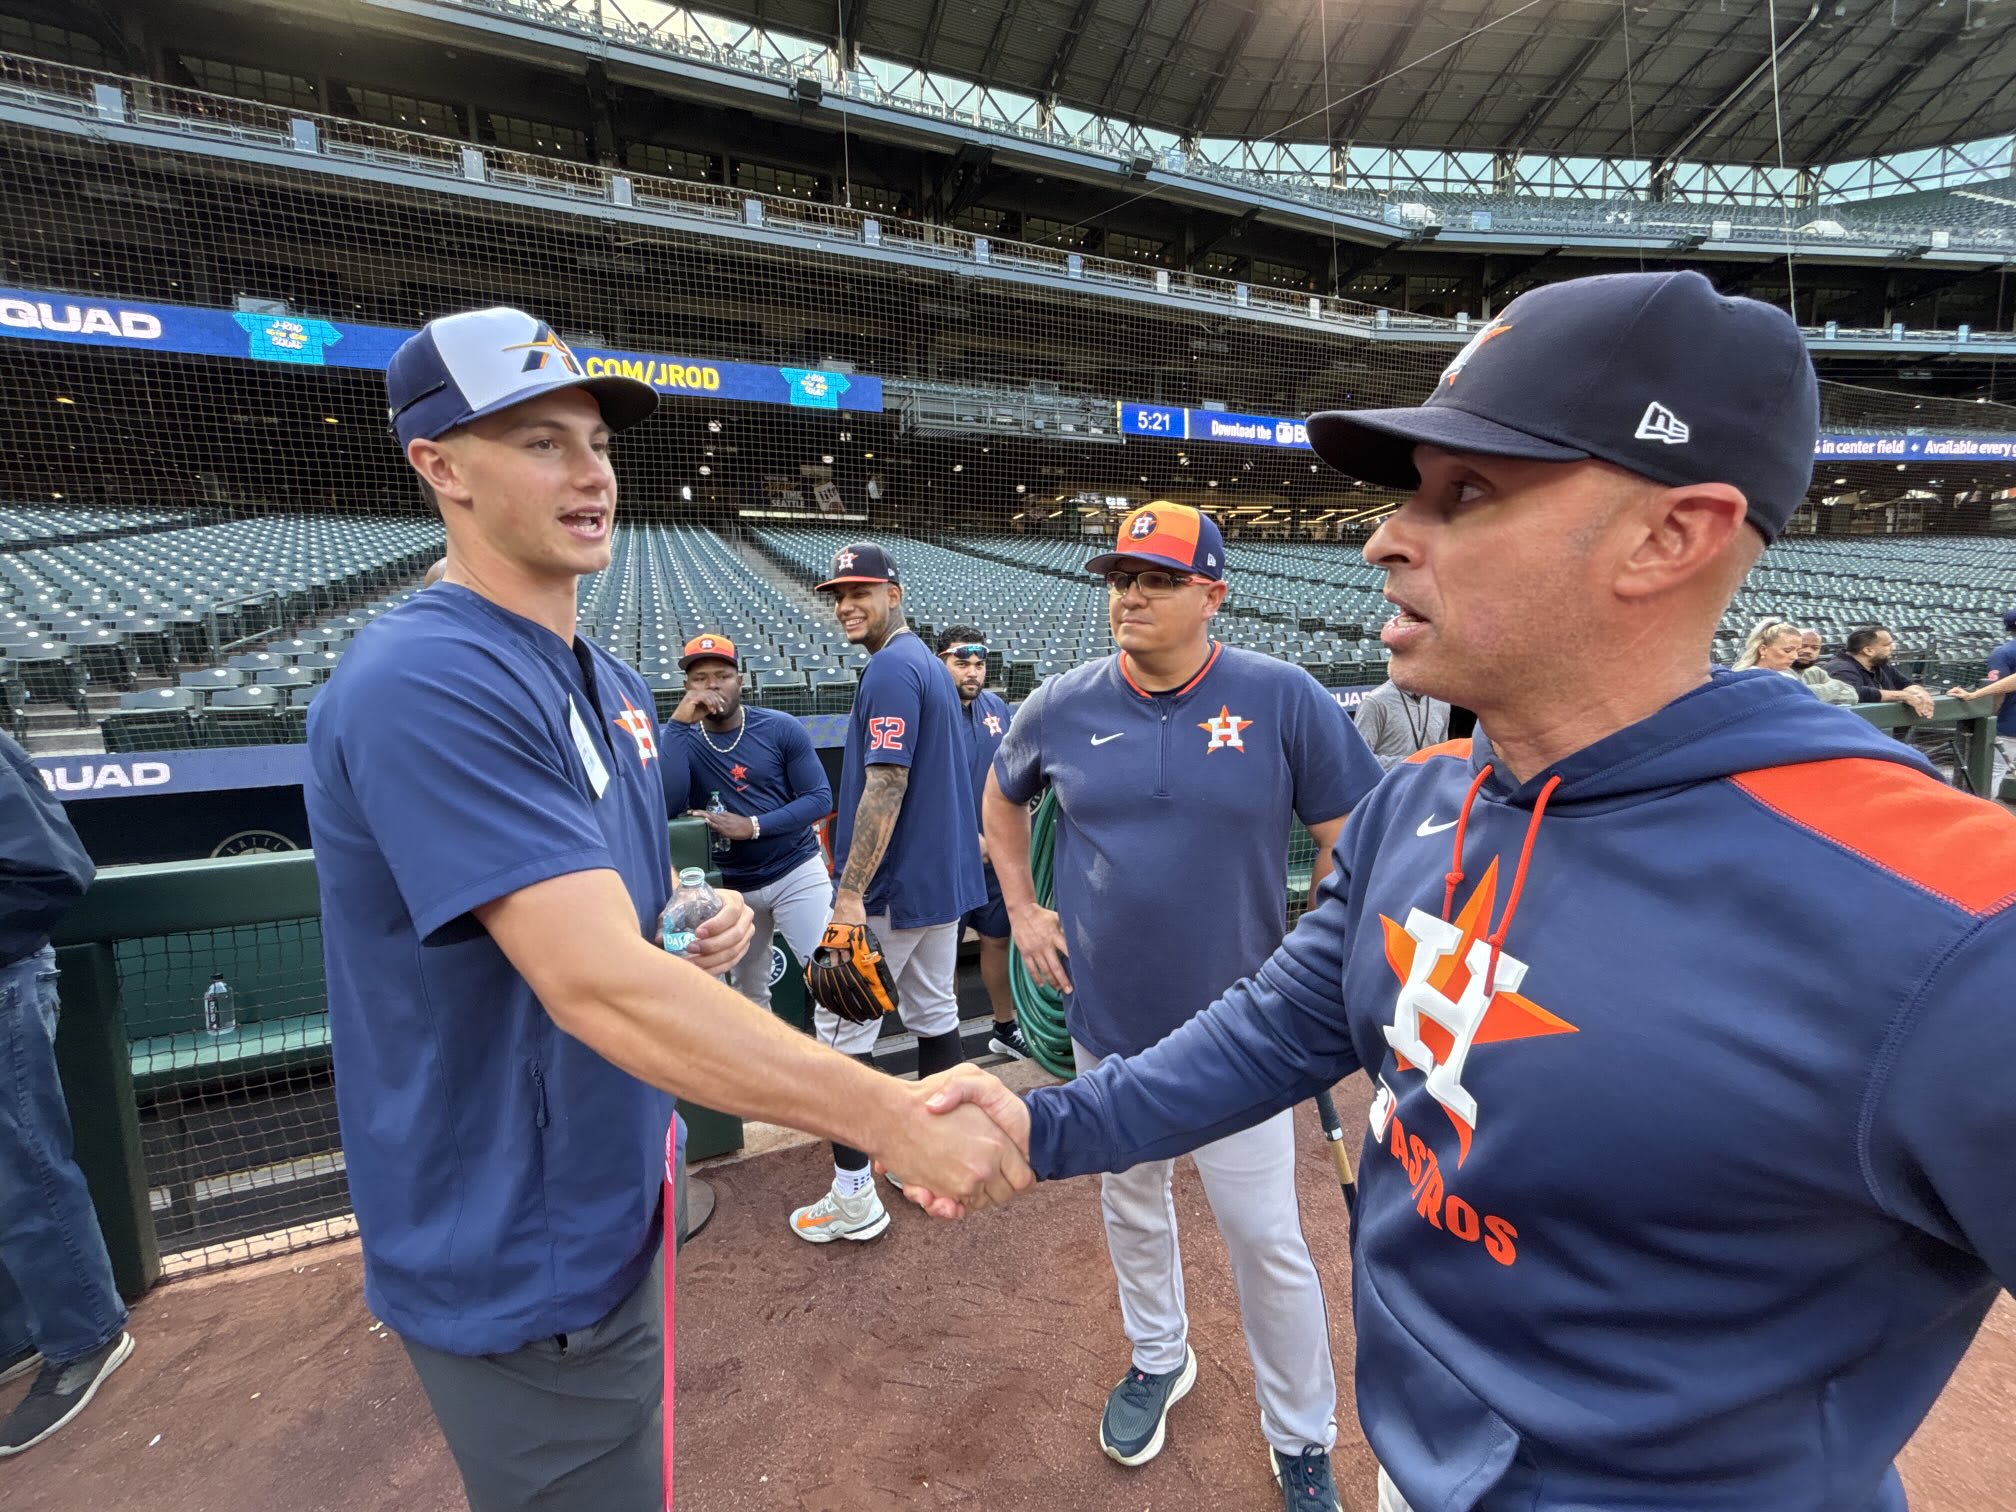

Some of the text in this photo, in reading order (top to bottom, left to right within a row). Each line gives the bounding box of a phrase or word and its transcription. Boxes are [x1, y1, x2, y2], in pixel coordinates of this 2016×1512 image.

[0, 298, 162, 339] QUAD
[1137, 412, 1170, 430] 5:21
[1212, 420, 1255, 439] Download
[1257, 424, 1272, 440] the
[1822, 440, 1835, 454] in
[1836, 441, 1875, 454] center
[1877, 440, 1905, 454] field
[1924, 440, 1978, 454] Available
[1979, 443, 2012, 457] every
[1330, 691, 1370, 707] UA
[869, 717, 906, 750] 52
[1390, 1115, 1518, 1267] ASTROS
